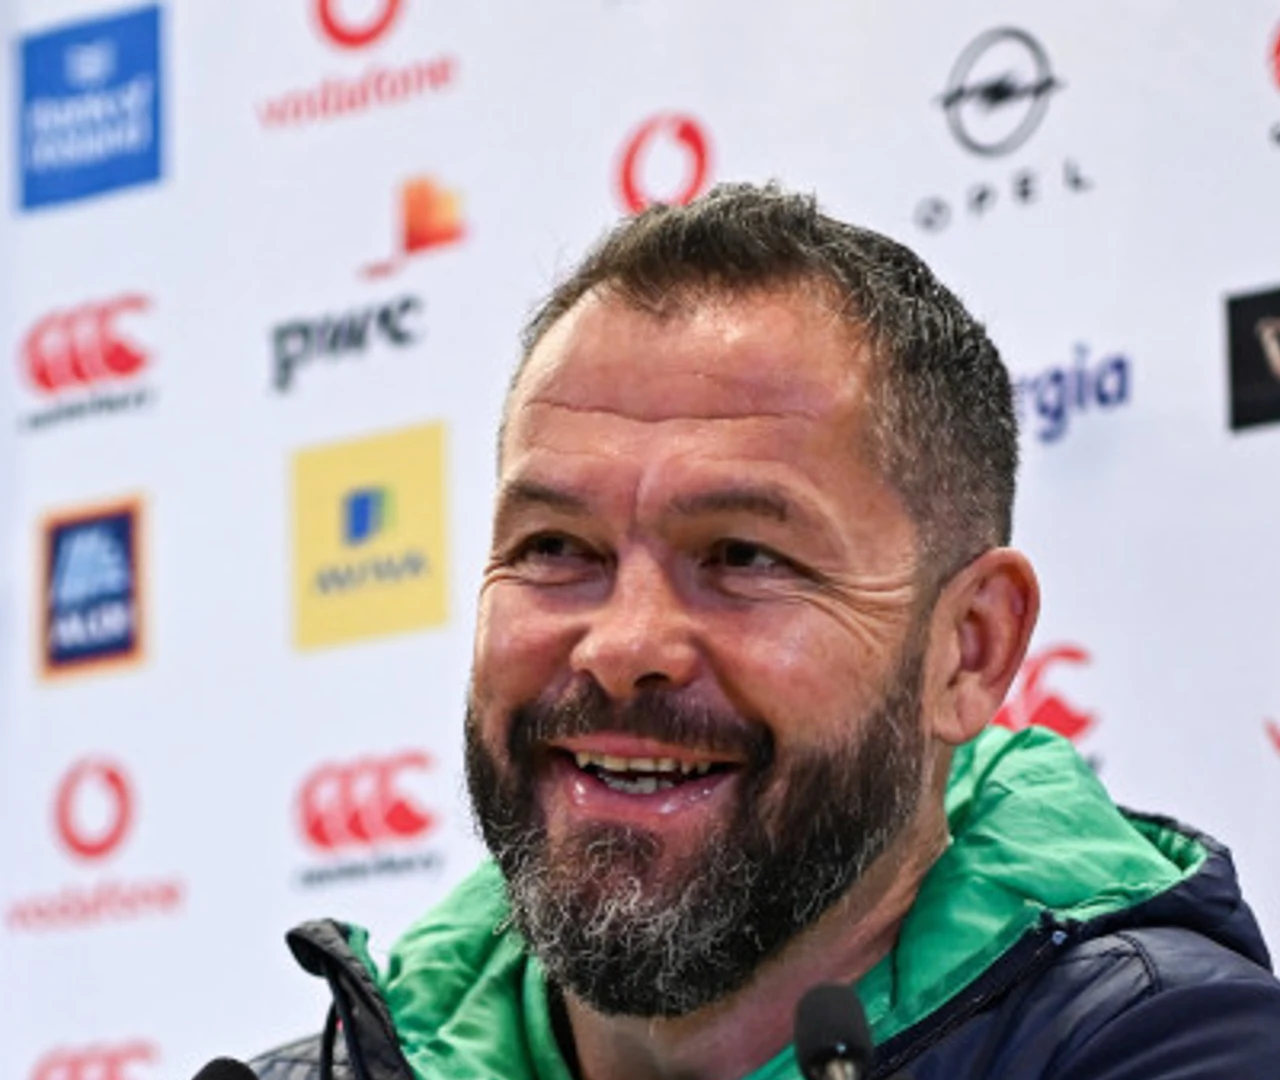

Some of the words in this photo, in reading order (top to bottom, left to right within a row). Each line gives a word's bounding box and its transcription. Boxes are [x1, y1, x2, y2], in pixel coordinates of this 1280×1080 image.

[915, 160, 1093, 232] OPEL
[270, 293, 422, 393] pwc
[1016, 340, 1132, 445] rgia
